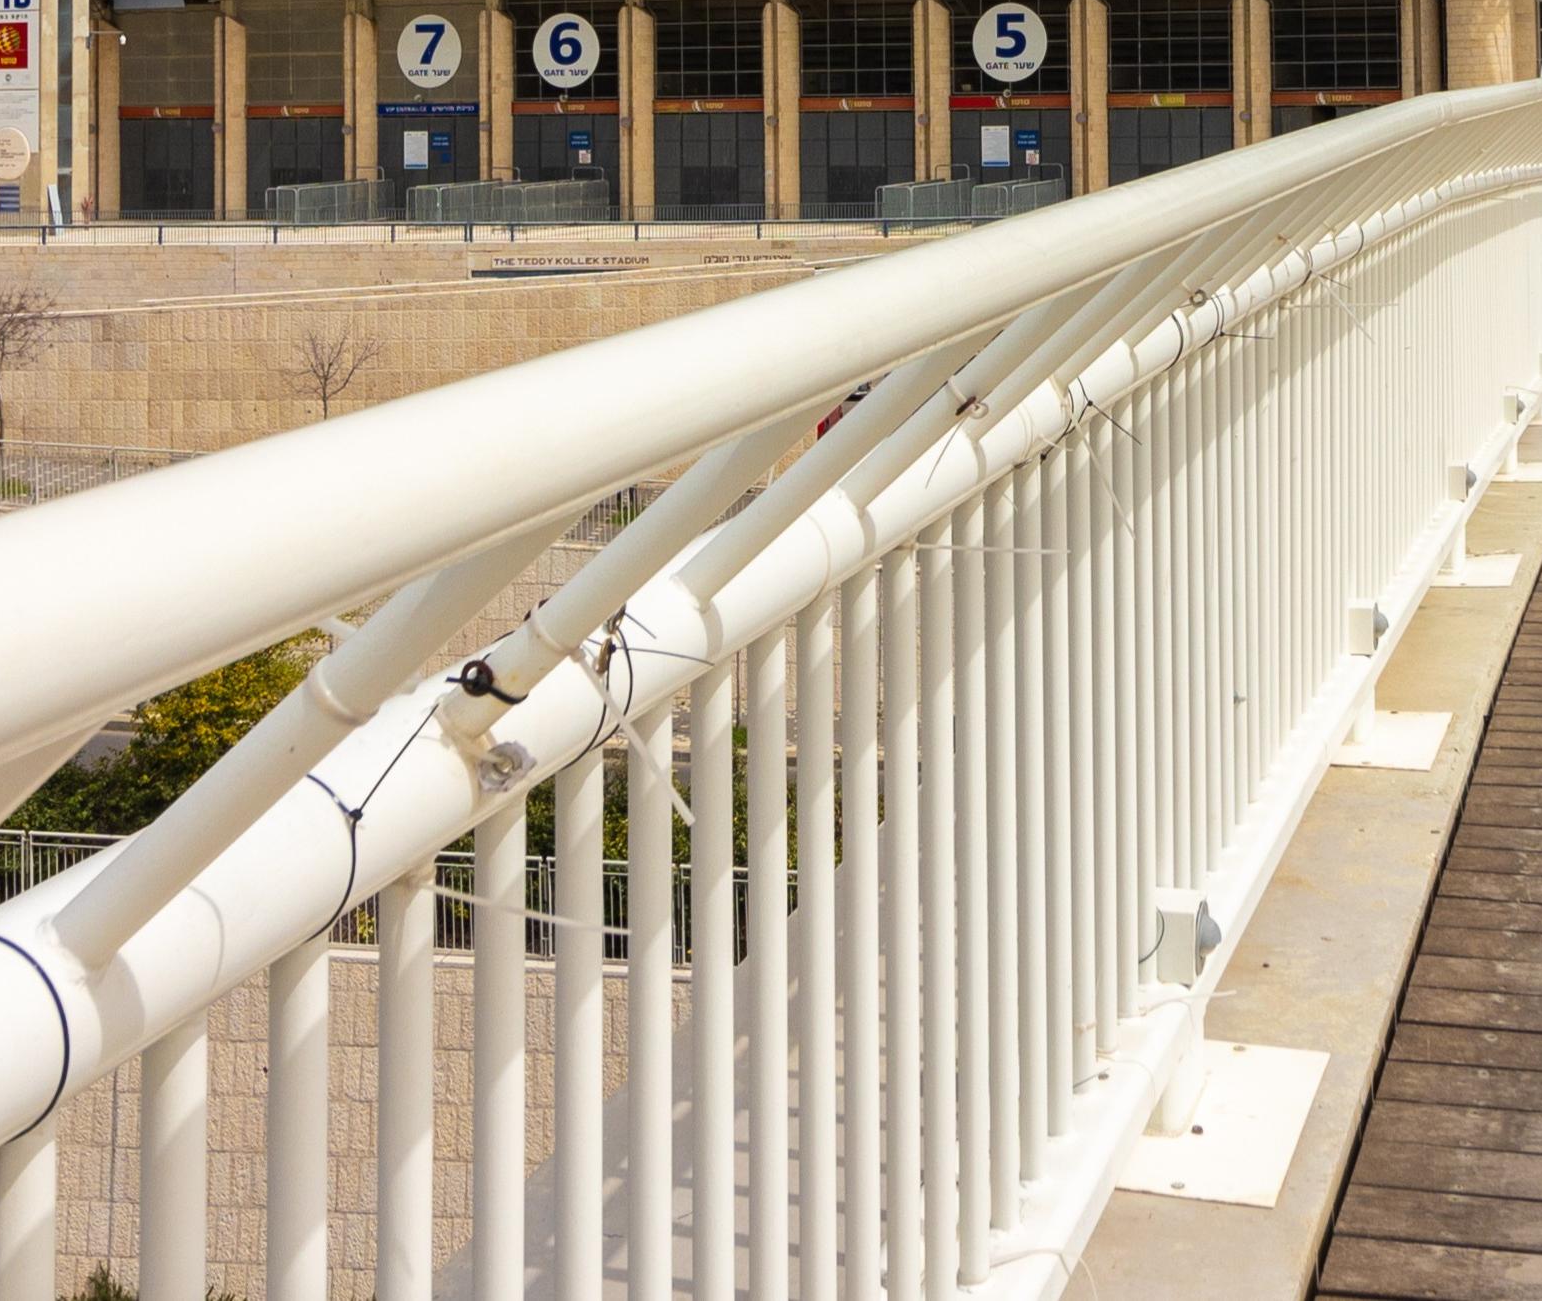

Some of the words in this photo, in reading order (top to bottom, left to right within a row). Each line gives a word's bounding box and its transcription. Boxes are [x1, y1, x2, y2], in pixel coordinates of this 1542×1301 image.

[415, 24, 445, 65] 7
[549, 21, 582, 66] 6
[995, 12, 1027, 58] 5
[985, 62, 1009, 70] GATE
[1013, 62, 1035, 70] שער
[494, 258, 514, 266] THE
[517, 257, 553, 265] TEDDY
[555, 257, 599, 265] KOLLEK
[602, 257, 649, 265] STADIUM
